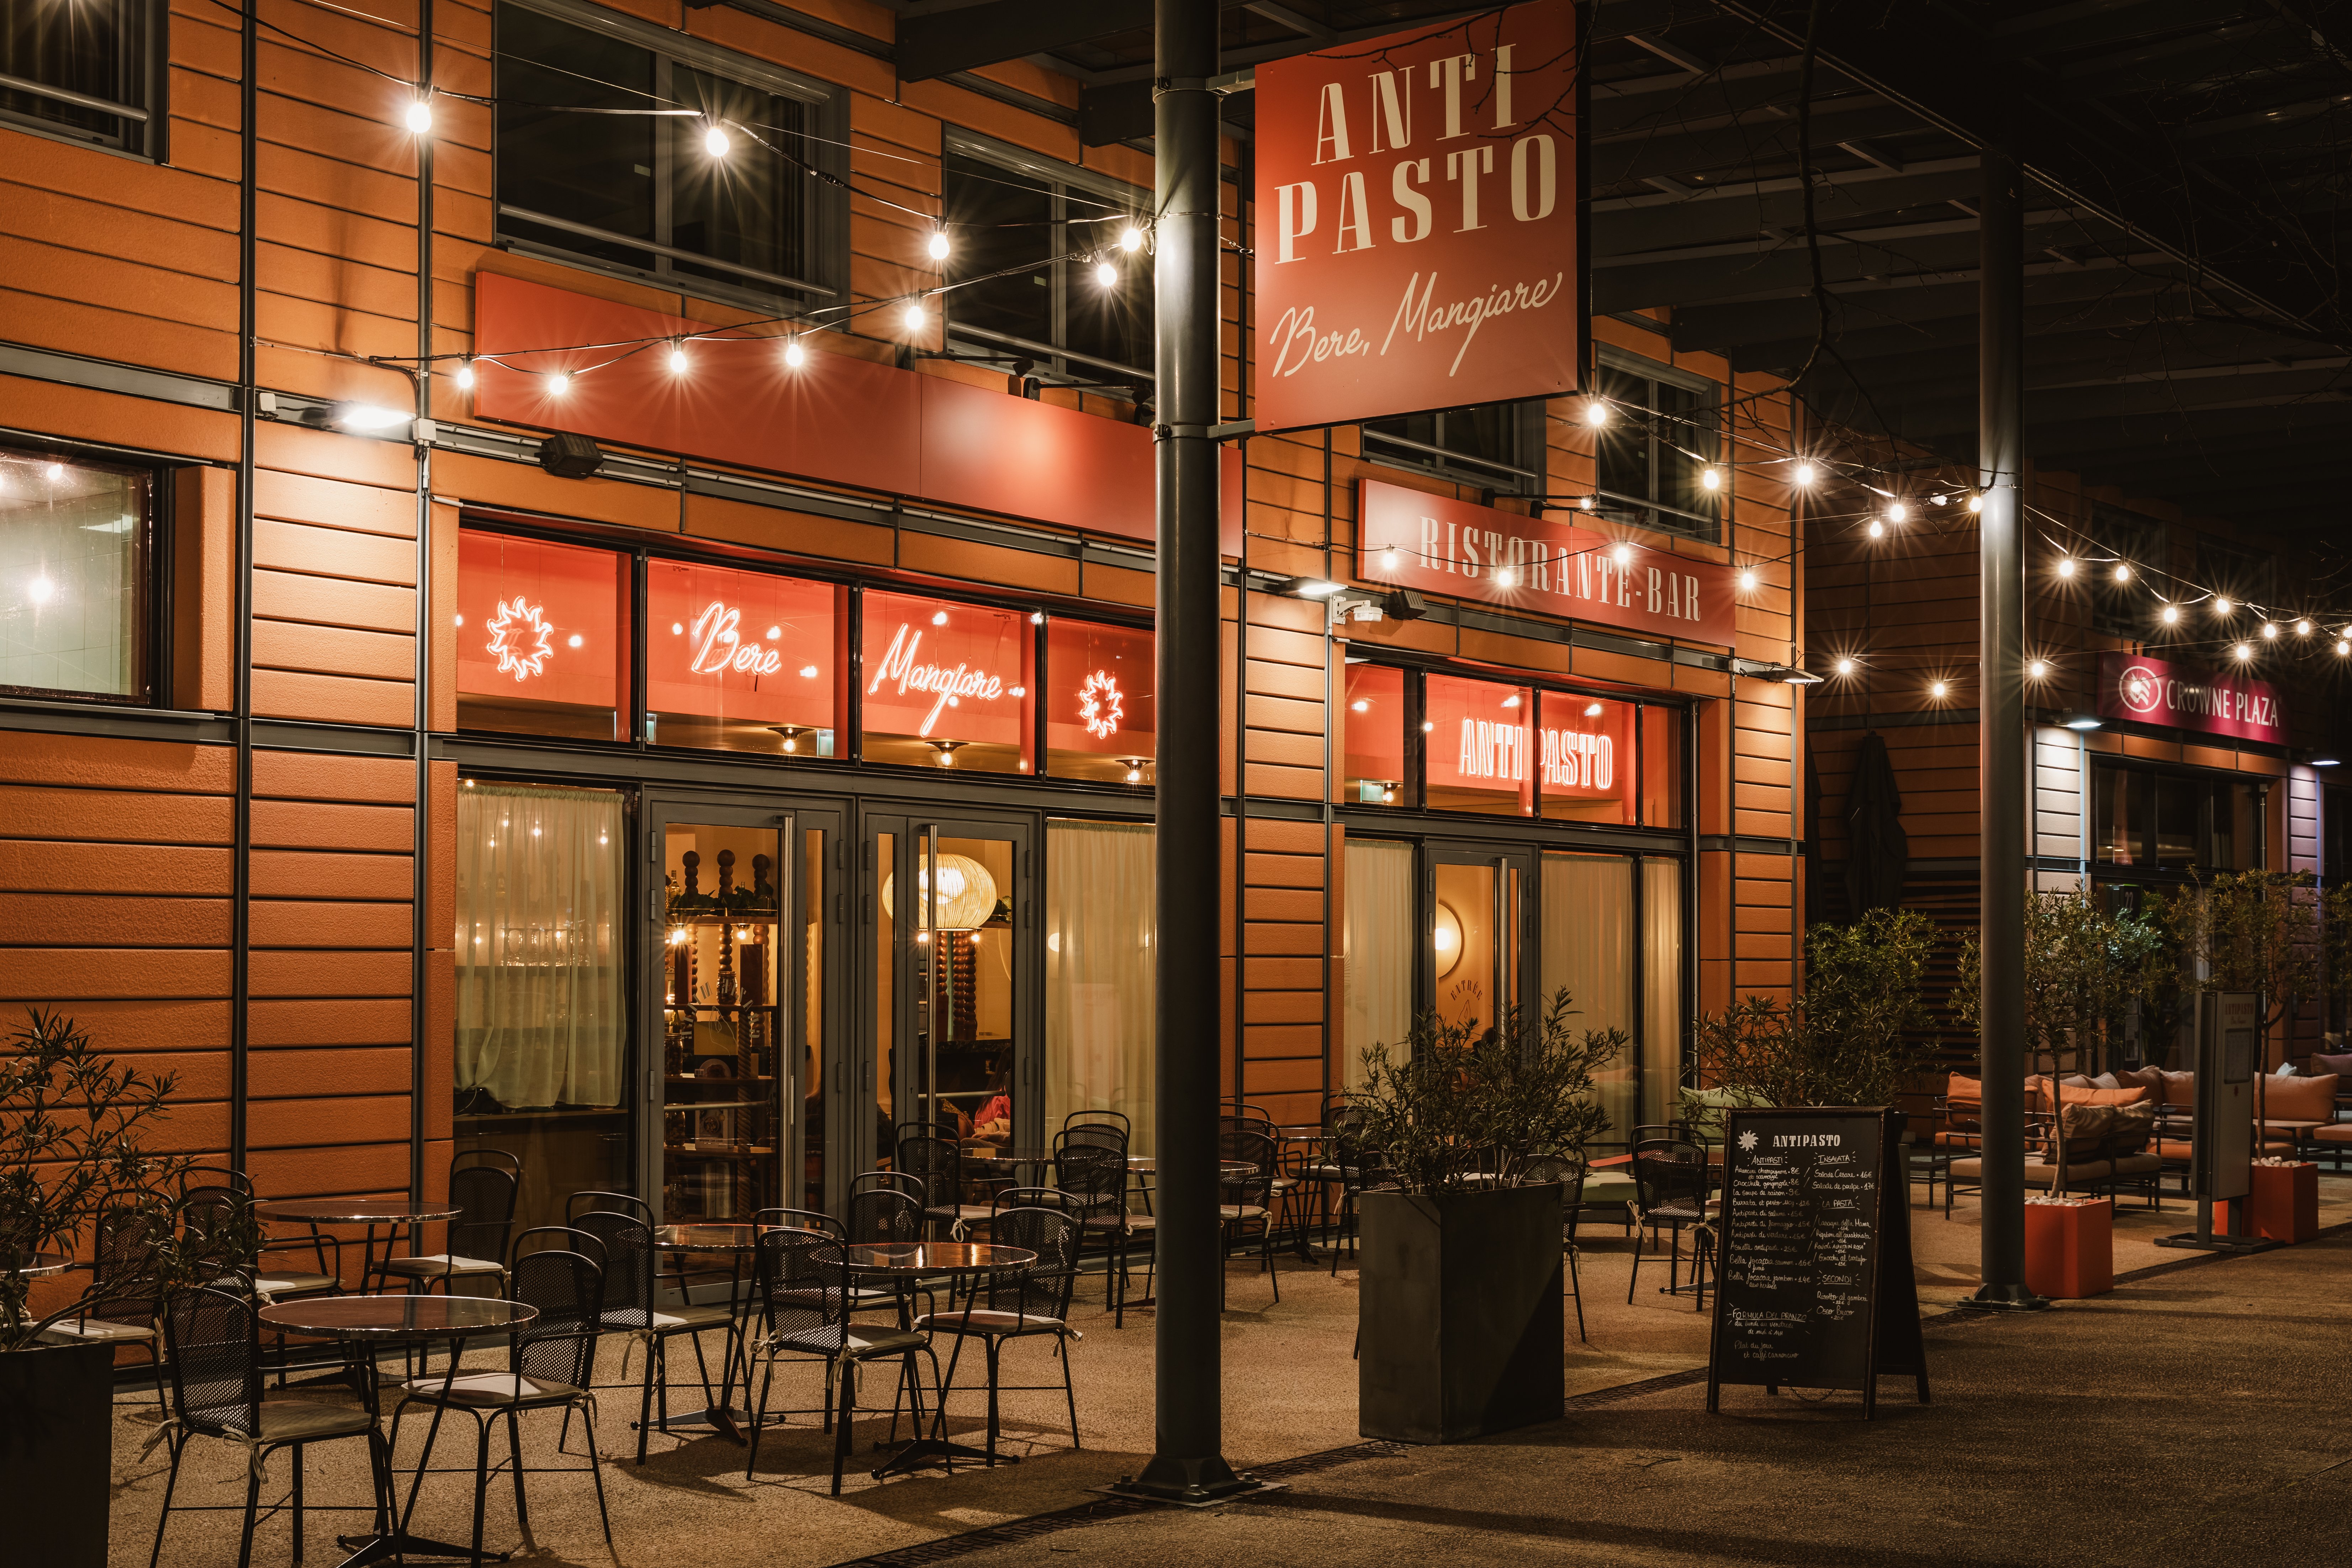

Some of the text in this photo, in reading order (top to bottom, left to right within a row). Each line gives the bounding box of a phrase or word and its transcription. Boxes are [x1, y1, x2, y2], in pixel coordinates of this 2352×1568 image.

[1311, 43, 1517, 166] ANTI
[1275, 134, 1556, 265] PASTO
[1270, 271, 1563, 378] Bere, Mangiare
[690, 600, 782, 675] Bere
[867, 622, 1003, 739] Mangiare
[2166, 679, 2279, 727] CROWNE PLAZA
[1450, 980, 1482, 1001] ENTRÉE
[1773, 1134, 1840, 1147] ANTIPASTO
[1751, 1155, 1783, 1165] ANTIPASTI
[1818, 1154, 1850, 1163] INSALATA
[1814, 1169, 1834, 1178] Salade
[1812, 1181, 1833, 1189] Salade
[1843, 1183, 1861, 1192] poulpe
[1733, 1198, 1758, 1206] Burrata
[1833, 1199, 1853, 1207] PASTA
[1732, 1208, 1759, 1218] Antipasti
[1732, 1218, 1758, 1229] Antipasti
[1841, 1218, 1854, 1226] della
[1731, 1228, 1758, 1239] Antipasti
[1754, 1242, 1780, 1252] antipasti
[1729, 1254, 1747, 1265] Bella
[1728, 1269, 1744, 1281] Bella
[1746, 1272, 1772, 1285] focaccia
[1772, 1273, 1793, 1285] jambon
[1822, 1273, 1852, 1283] SECONDI
[1817, 1290, 1839, 1301] Risotto
[1839, 1292, 1846, 1301] al
[1732, 1308, 1807, 1320] FORMULA DEL PRANZO
[1816, 1305, 1835, 1315] Osso
[1769, 1321, 1795, 1329] vendredi
[1734, 1340, 1749, 1350] Plat
[1759, 1340, 1774, 1352] jour
